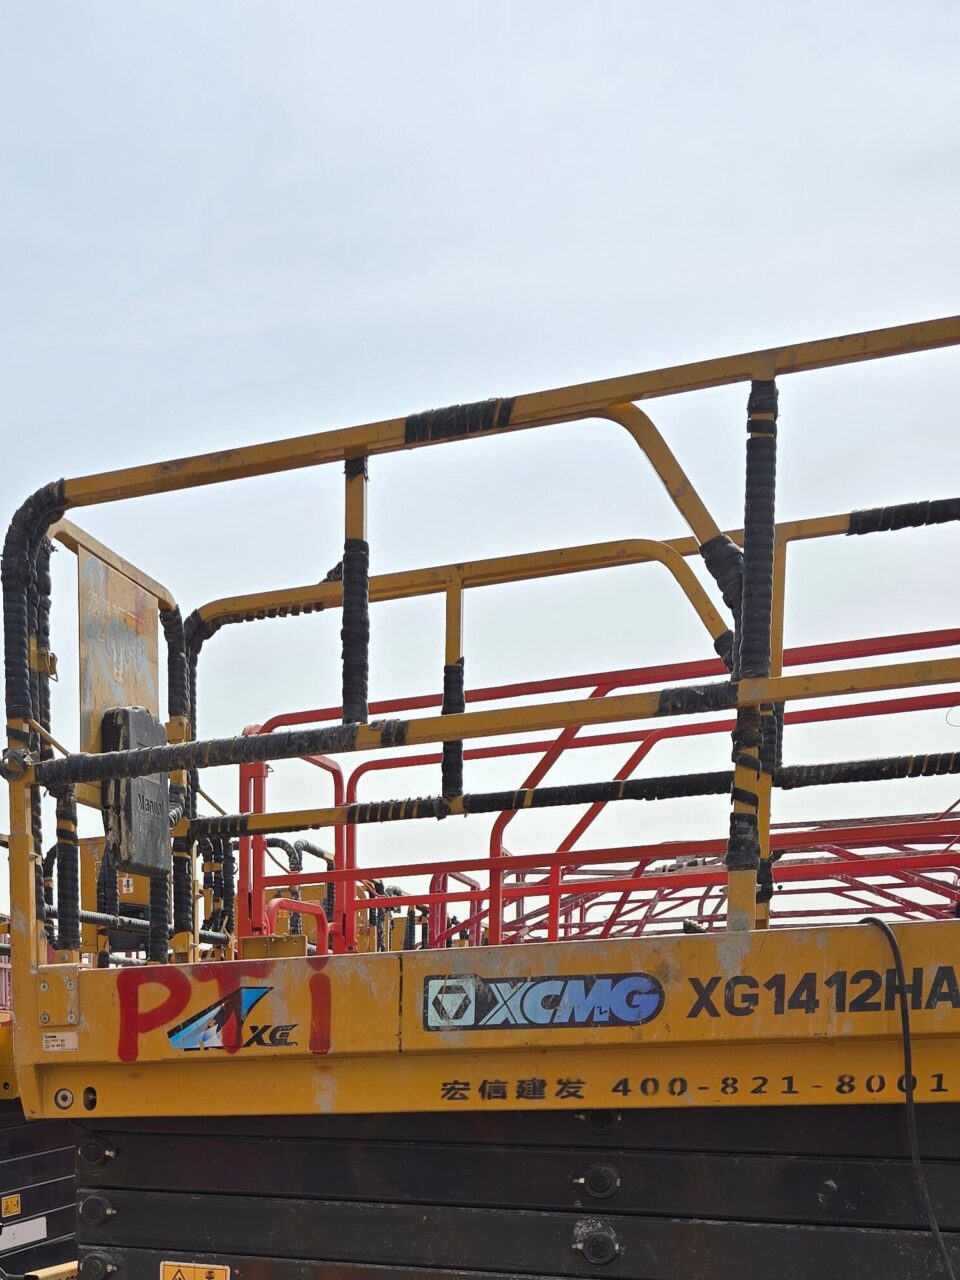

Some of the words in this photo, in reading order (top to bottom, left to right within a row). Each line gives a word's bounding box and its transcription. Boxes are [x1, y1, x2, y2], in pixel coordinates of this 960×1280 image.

[477, 975, 660, 1026] XCMG
[440, 1079, 586, 1101] 宏信建发
